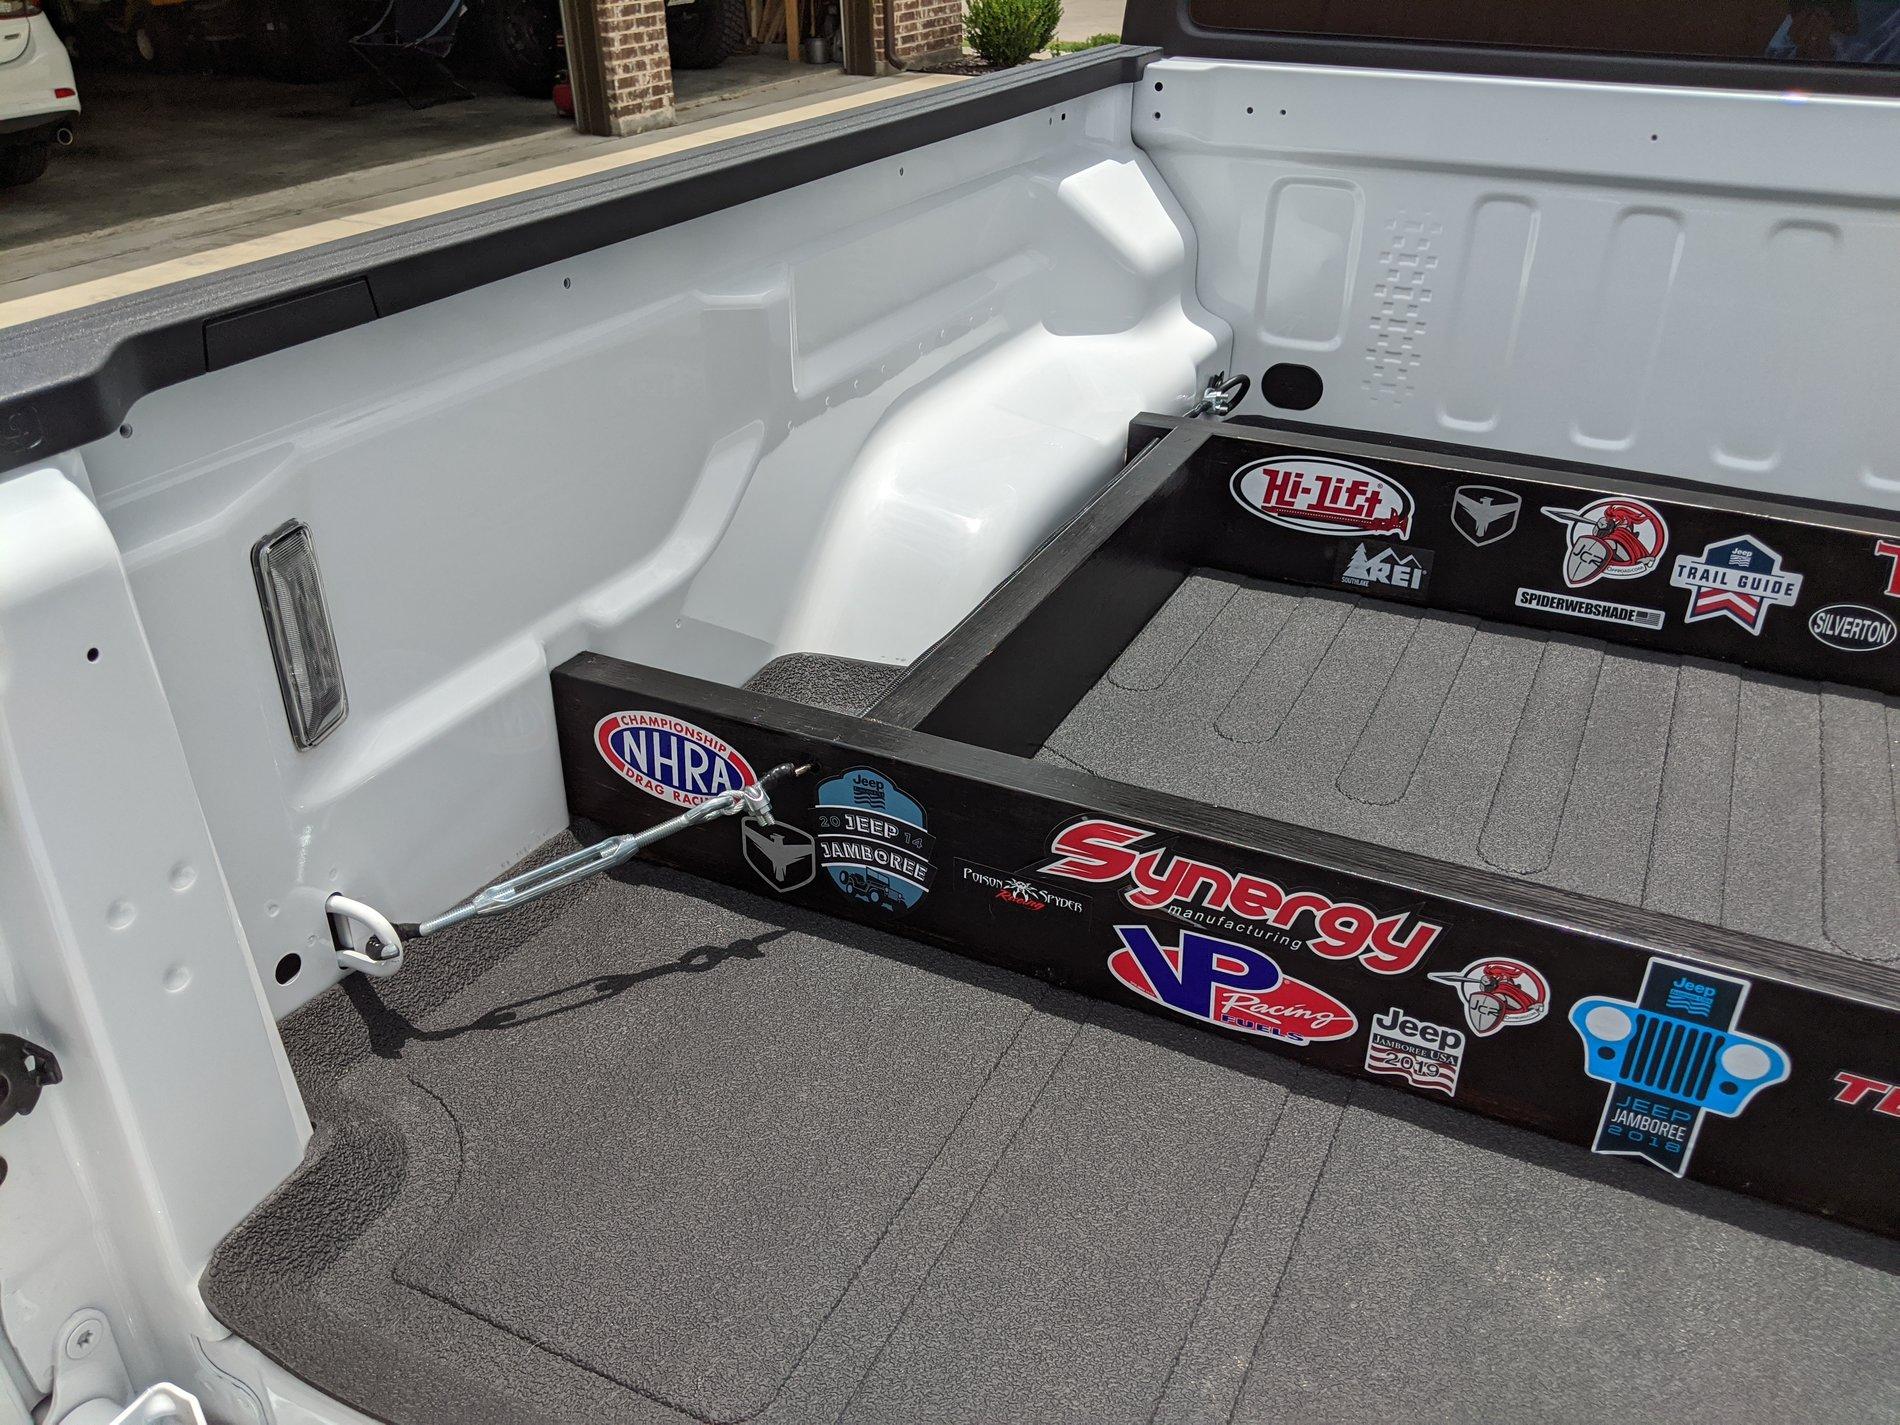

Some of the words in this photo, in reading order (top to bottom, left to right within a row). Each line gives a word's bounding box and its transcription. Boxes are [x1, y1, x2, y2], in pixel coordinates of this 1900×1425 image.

[1262, 469, 1383, 518] Hi-Lift
[1731, 547, 1753, 557] Jeep
[1341, 576, 1370, 588] SOUTHLAKE
[1375, 562, 1423, 590] REI
[1677, 564, 1728, 586] TRAIL
[1737, 575, 1795, 597] GUIDE
[1520, 591, 1636, 623] SPIDERWEBSHADE
[1814, 612, 1892, 644] SILVERTON
[620, 715, 727, 752] CHAMPIONSHIP
[622, 730, 731, 794] NHRA
[626, 766, 665, 795] DRAG
[853, 774, 885, 790] Jeep
[844, 814, 900, 839] JEEP
[820, 841, 929, 881] JAMBOREE
[1038, 818, 1444, 975] Synergy
[1168, 903, 1303, 951] manufacturing
[1113, 925, 1283, 1021] VP
[1673, 977, 1716, 997] Jeep
[1221, 991, 1342, 1029] Racing
[1220, 1014, 1305, 1042] FUELS
[1376, 1010, 1462, 1051] Jeep
[1374, 1035, 1427, 1058] JAMBOREE
[1430, 1050, 1455, 1065] USA
[1384, 1052, 1440, 1077] 2019
[1616, 1096, 1692, 1121] JEEP
[1608, 1125, 1680, 1153] 2018
[1611, 1108, 1687, 1142] JAMBOREE
